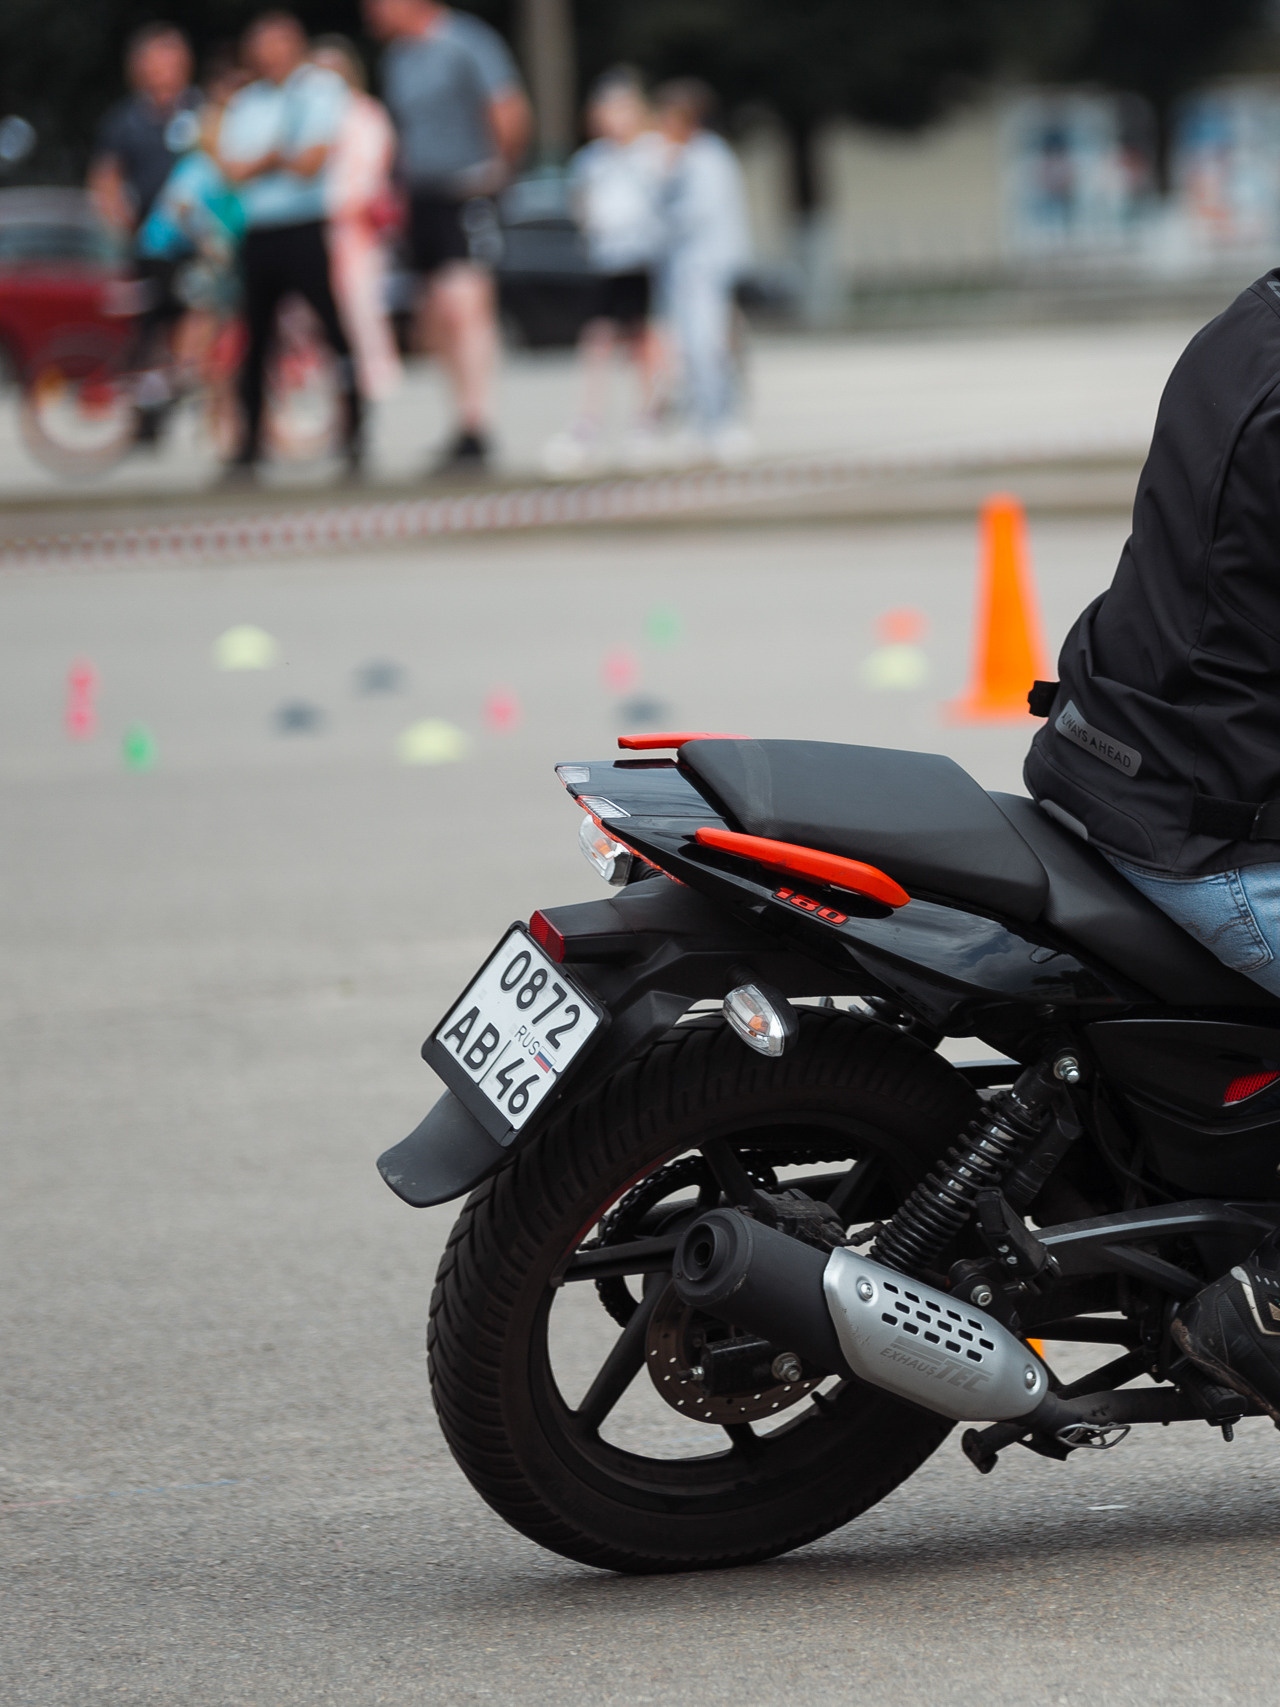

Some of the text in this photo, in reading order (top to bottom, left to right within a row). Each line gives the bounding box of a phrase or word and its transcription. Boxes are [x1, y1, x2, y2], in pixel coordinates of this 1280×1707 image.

[1091, 737, 1131, 768] AHEAD
[774, 886, 849, 924] 180
[500, 950, 581, 1050] 0872
[514, 1025, 541, 1056] RUS
[496, 1057, 541, 1115] 46
